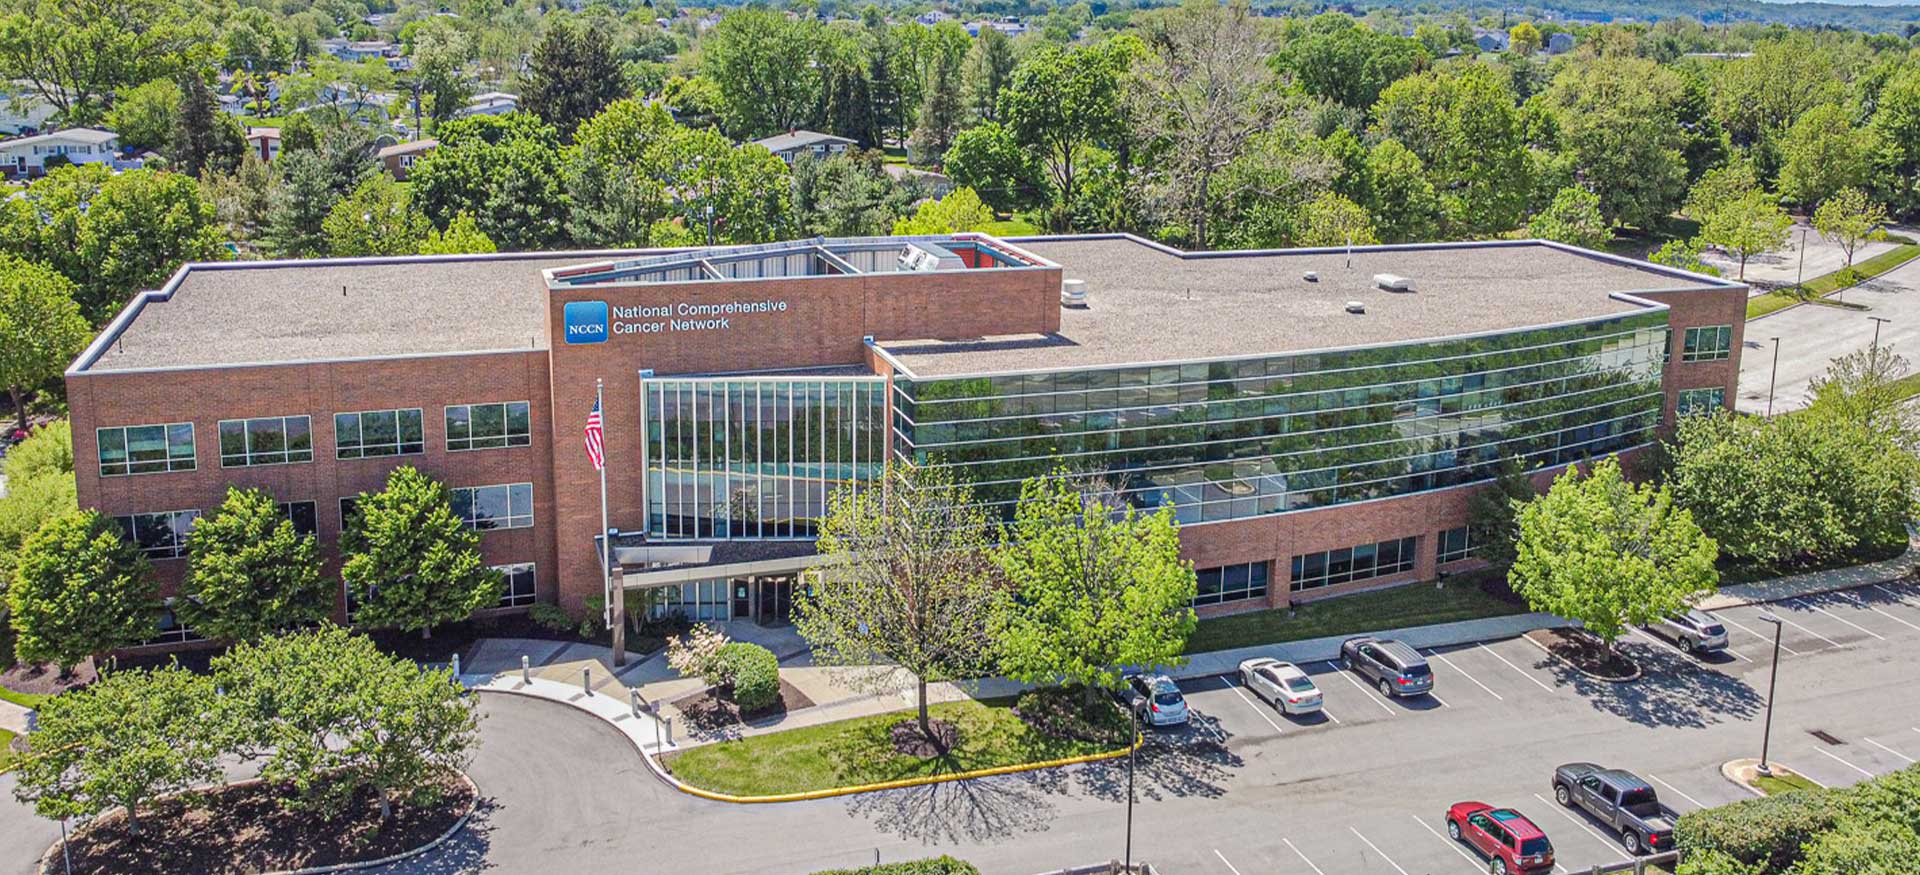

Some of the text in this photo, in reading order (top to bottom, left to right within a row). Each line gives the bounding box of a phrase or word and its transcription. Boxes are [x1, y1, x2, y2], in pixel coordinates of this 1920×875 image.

[613, 300, 788, 318] National Comprehensive
[569, 324, 604, 334] NCCN
[613, 317, 730, 334] Cancer Network
